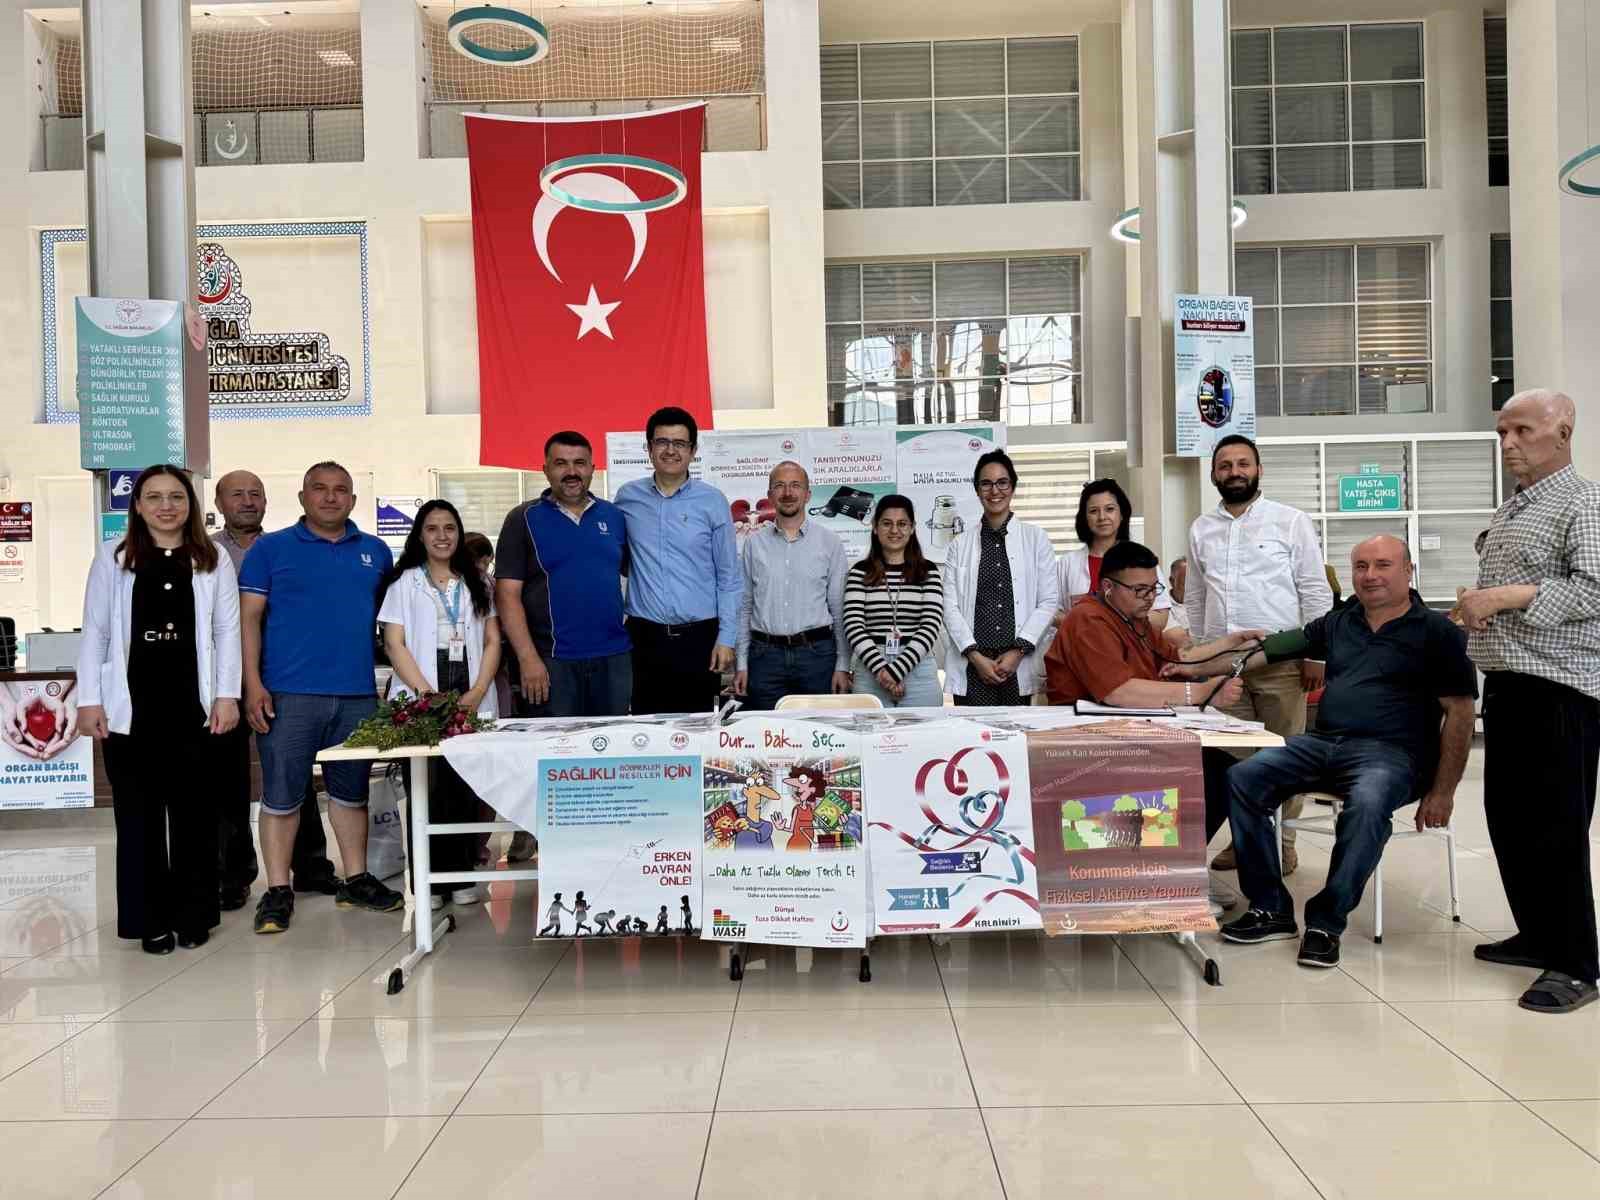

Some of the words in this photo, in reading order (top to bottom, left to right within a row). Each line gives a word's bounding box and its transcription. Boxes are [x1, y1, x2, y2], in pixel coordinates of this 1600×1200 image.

[1238, 301, 1249, 312] VE
[208, 318, 240, 340] ĞLA
[215, 341, 318, 365] ÜNİVERSİTESİ
[255, 367, 338, 391] HASTANESİ
[92, 406, 160, 416] LABORATUVARLAR
[92, 430, 132, 439] ULTRASON
[93, 455, 105, 463] MR
[1357, 479, 1385, 489] HASTA
[5, 763, 42, 774] ORGAN
[44, 760, 80, 773] BAĞIŞI
[664, 763, 692, 781] İÇİN
[34, 774, 88, 784] KURTARIR
[547, 766, 616, 782] SAĞLIKLI
[654, 851, 691, 863] ERKEN
[642, 864, 691, 875] DAVRAN
[1069, 864, 1137, 881] Korunmak
[1046, 887, 1094, 904] Fiziksel
[771, 915, 791, 923] Dikkat
[712, 927, 746, 938] WASH
